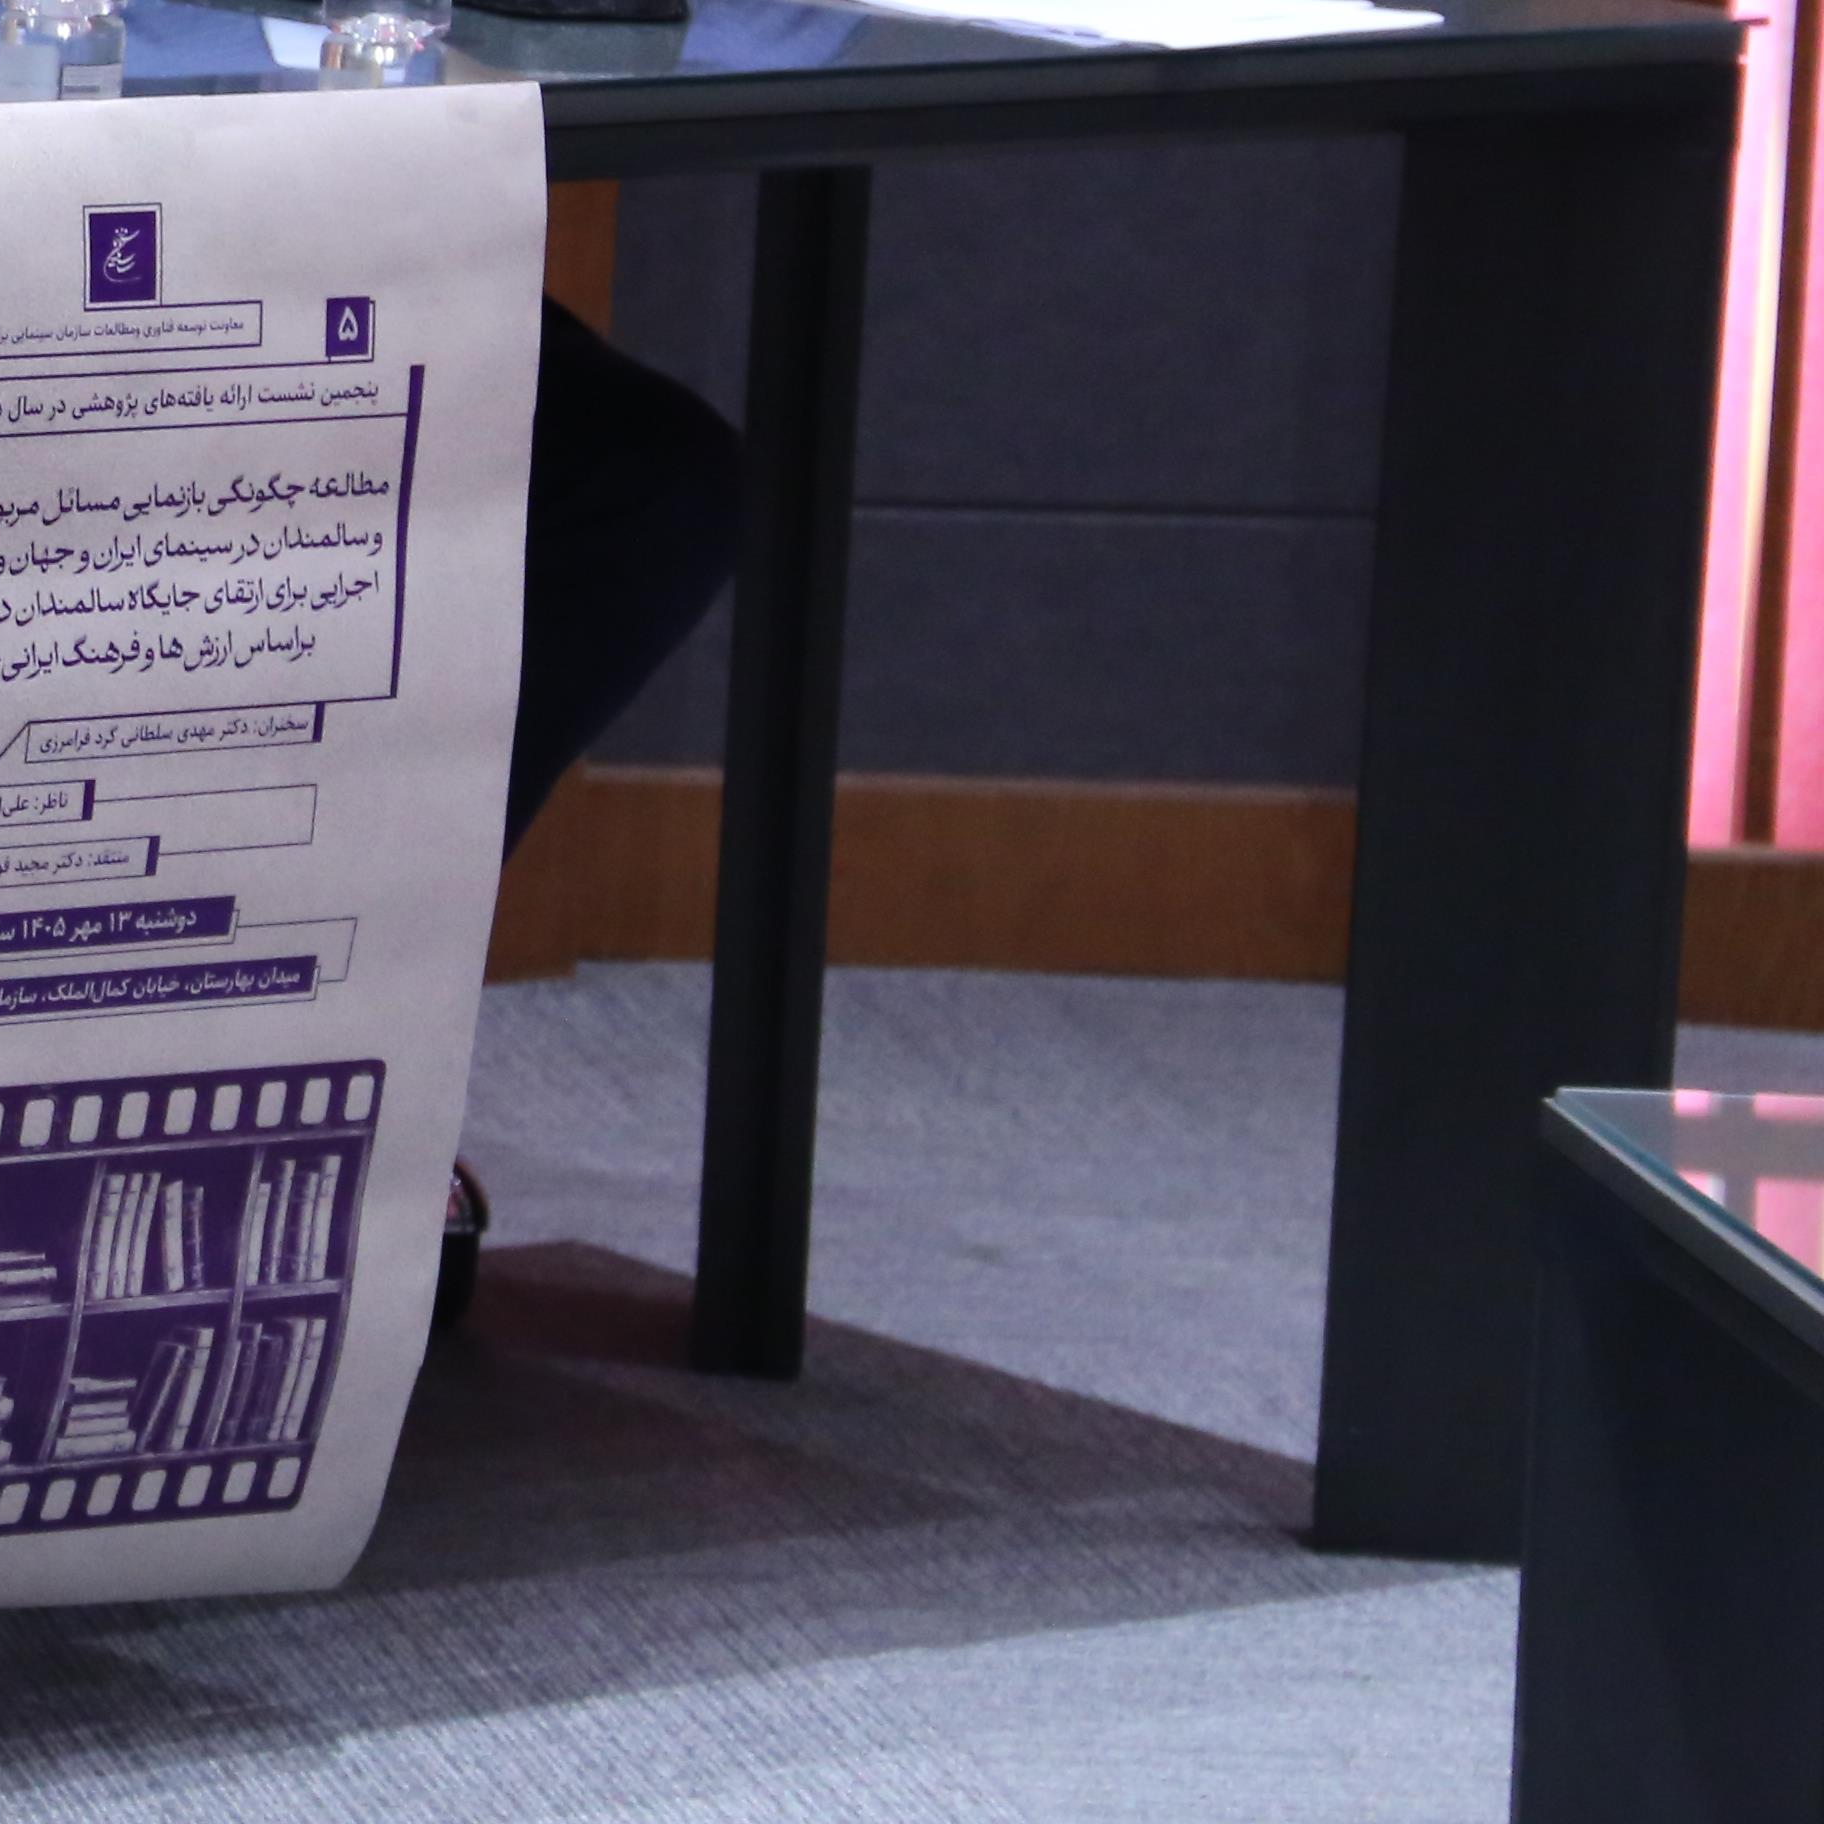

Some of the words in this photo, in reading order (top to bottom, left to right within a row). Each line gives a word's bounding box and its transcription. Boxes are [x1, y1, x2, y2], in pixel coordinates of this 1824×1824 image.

[11, 327, 52, 345] سینمایی
[56, 325, 92, 341] سازمان
[177, 321, 207, 336] توسعه
[337, 306, 359, 342] ۵
[72, 392, 139, 419] پژوهشی
[220, 383, 252, 411] ارائه
[257, 381, 316, 403] نشست
[320, 380, 378, 407] پنجمین
[8, 395, 44, 423] سال
[48, 399, 66, 422] در
[207, 473, 305, 517] چگونگی
[308, 470, 390, 499] مطالعه
[42, 486, 121, 526] مسائل
[123, 480, 206, 522] بازنمایی
[92, 533, 141, 572] ایران
[143, 531, 232, 568] سینمای
[230, 533, 260, 564] در
[263, 522, 369, 561] سالمندان
[367, 529, 383, 556] و
[9, 540, 75, 576] جهان
[73, 548, 90, 574] و
[127, 579, 201, 616] جایگاه
[204, 577, 264, 614] ارتقای
[266, 575, 308, 612] برای
[310, 570, 380, 611] اجرایی
[15, 587, 125, 627] سالمندان
[61, 630, 140, 674] فرهنگ
[138, 647, 154, 673] و
[40, 727, 91, 753] فرامرزی
[121, 724, 173, 748] سلطانی
[177, 726, 214, 743] مهدی
[219, 718, 248, 741] دکتر
[14, 857, 49, 875] مجید
[52, 852, 83, 875] دکتر
[22, 915, 66, 939] ۱۴۰۵
[68, 919, 102, 943] مهر
[109, 910, 132, 933] ۱۳
[135, 907, 197, 935] دوشنبه
[132, 974, 181, 999] خیابان
[257, 966, 301, 990] میدان
